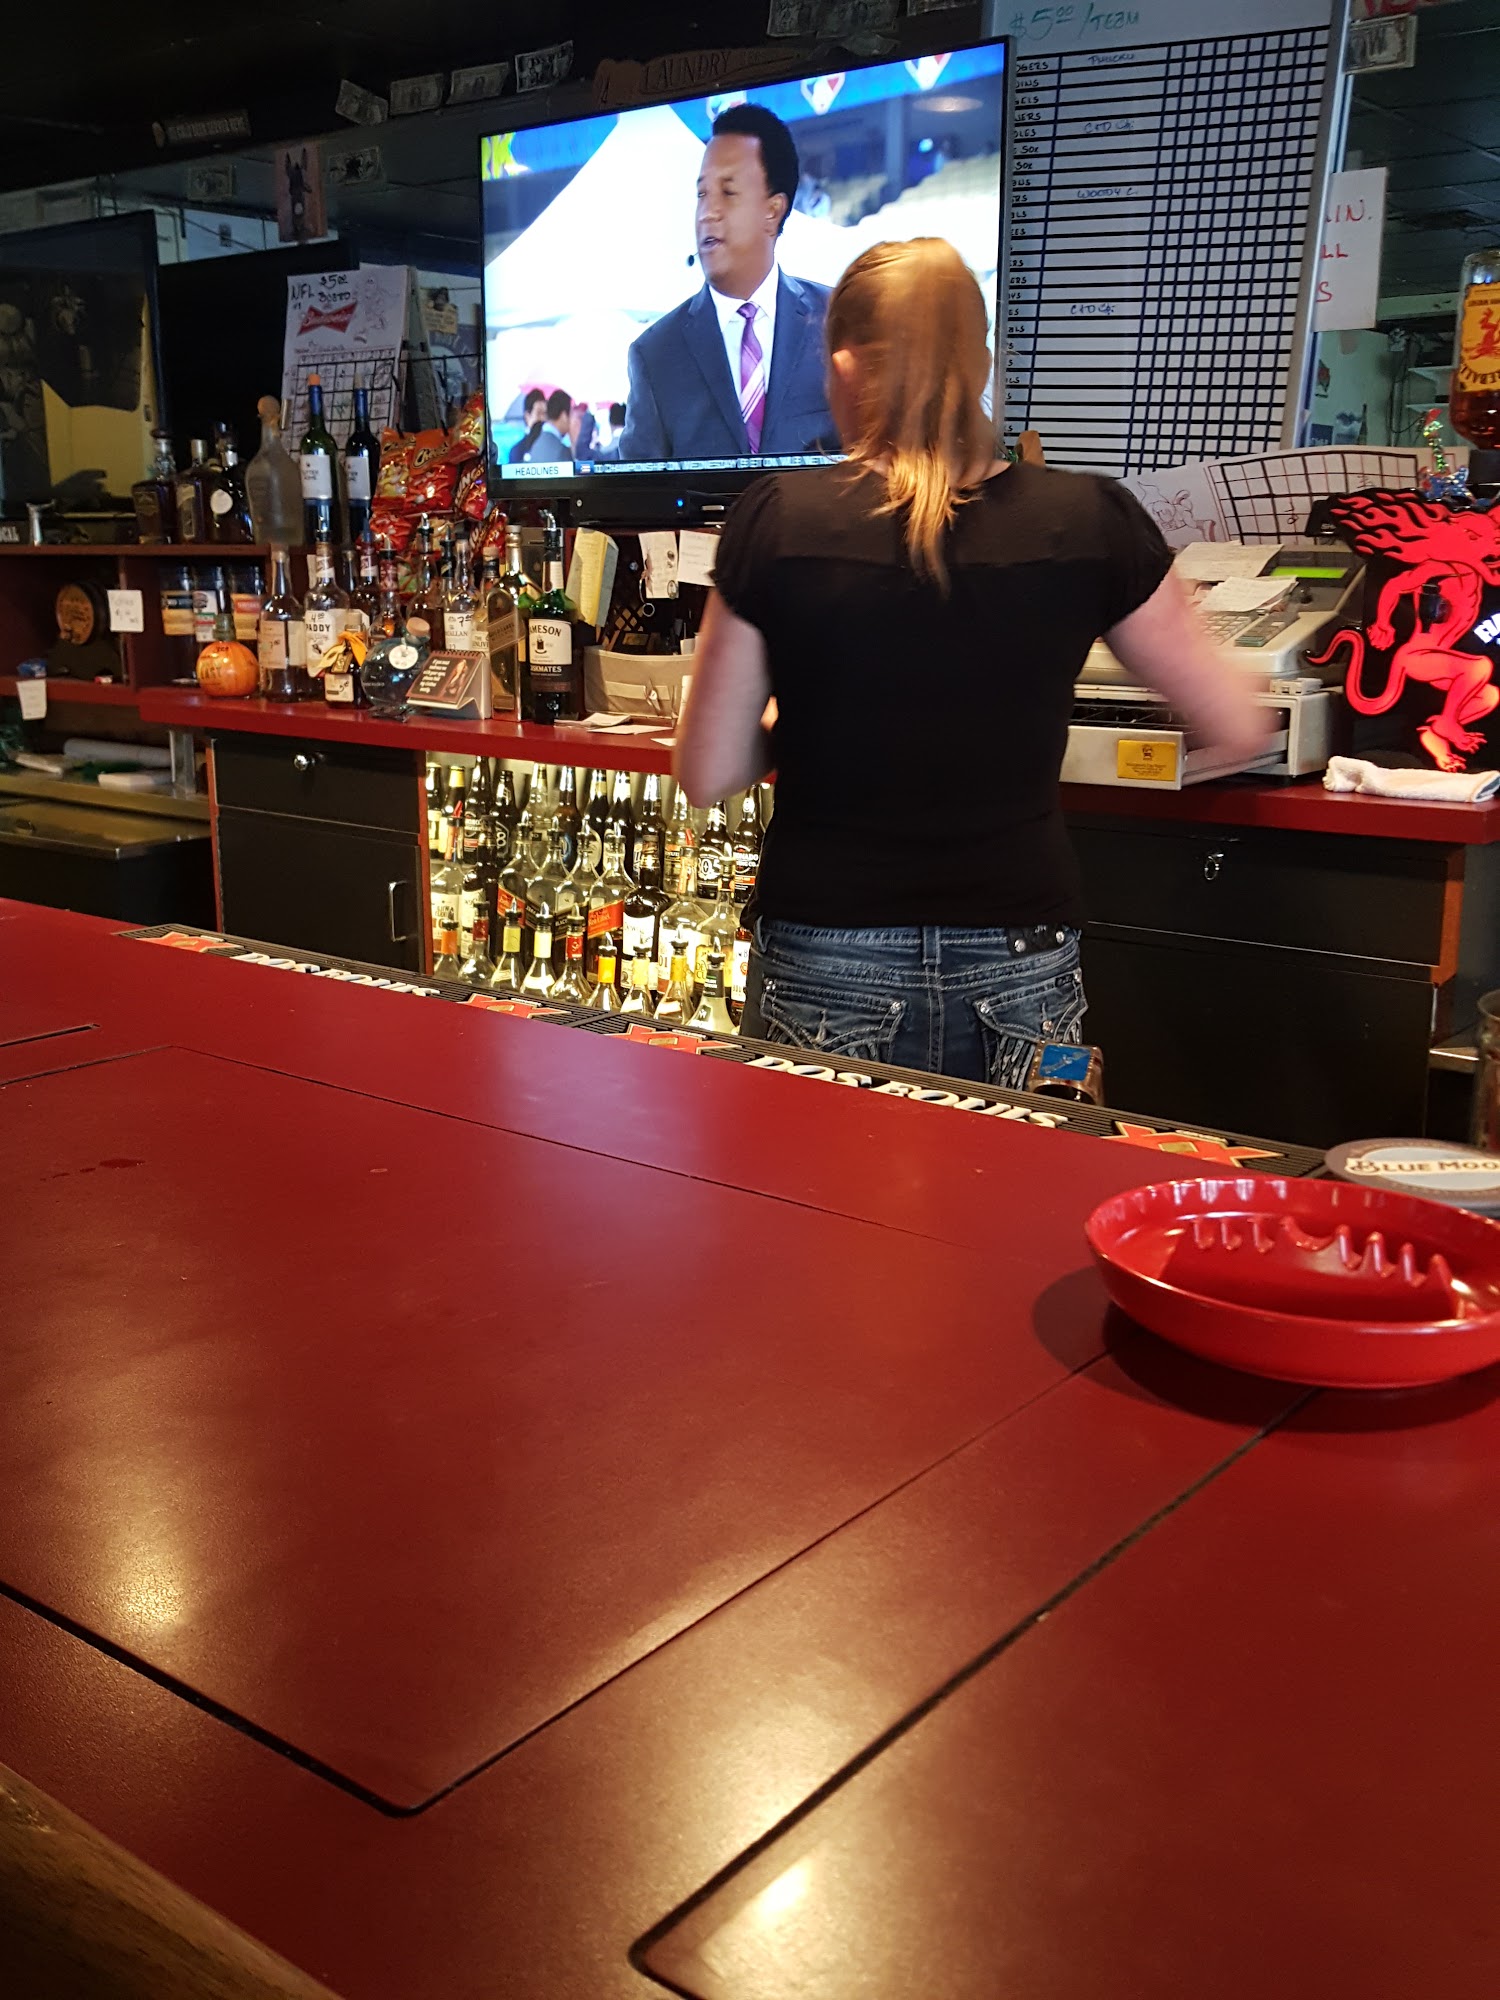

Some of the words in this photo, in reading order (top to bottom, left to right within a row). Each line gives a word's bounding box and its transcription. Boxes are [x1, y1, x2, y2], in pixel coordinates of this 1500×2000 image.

[645, 52, 731, 91] LAUNDRY
[1325, 199, 1372, 223] IN.
[515, 466, 559, 477] HEADLINES
[743, 1055, 872, 1088] DOS
[869, 1080, 1069, 1129] EQUIS
[1349, 1160, 1430, 1173] BLUE
